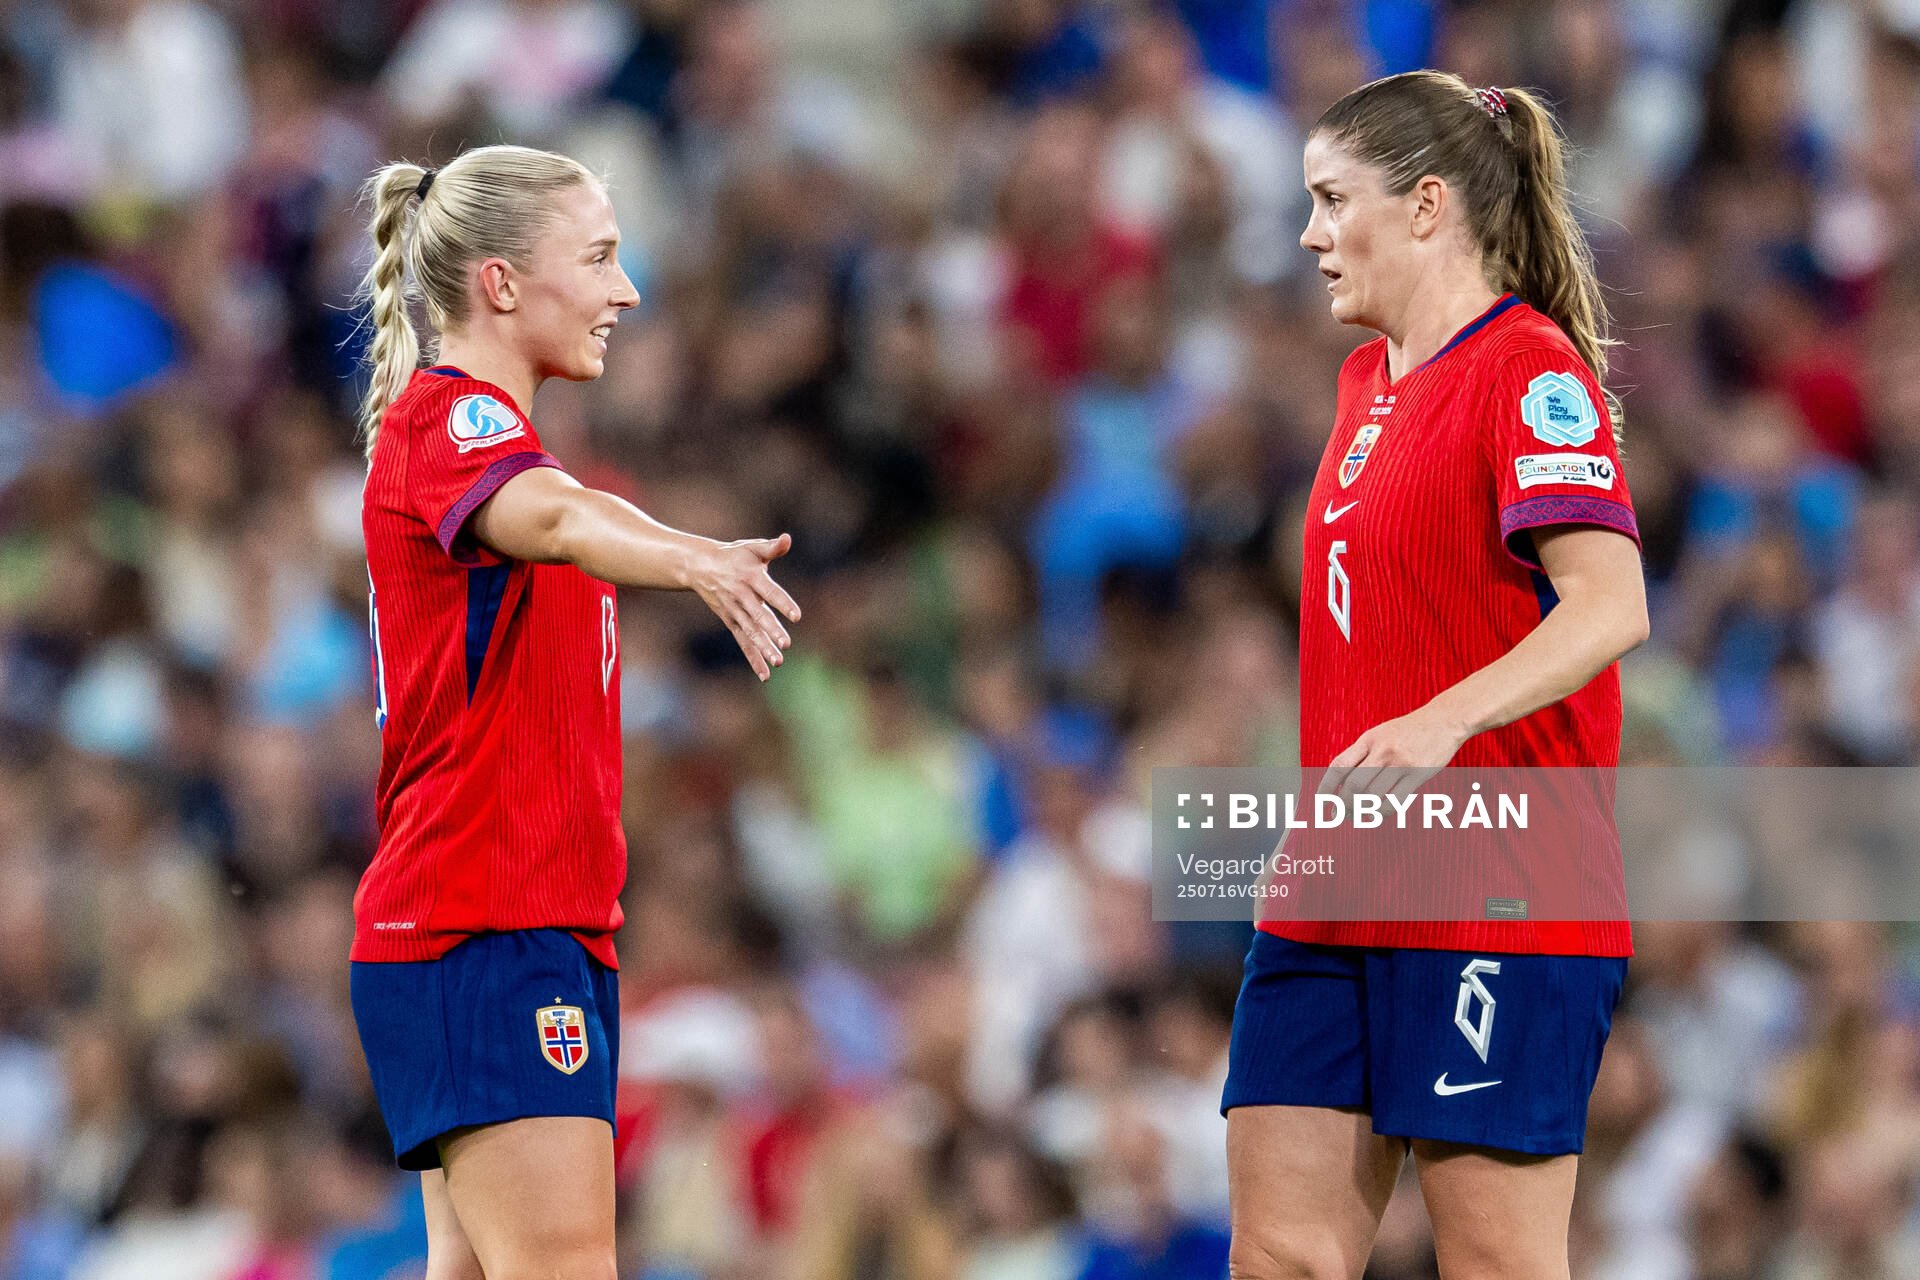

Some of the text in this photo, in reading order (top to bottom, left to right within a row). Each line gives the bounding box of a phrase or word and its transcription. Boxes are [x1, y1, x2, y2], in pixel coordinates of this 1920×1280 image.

[1546, 395, 1561, 404] We
[1548, 404, 1568, 414] Play
[1549, 412, 1580, 423] Strong
[1519, 463, 1586, 476] FOUNDATION
[1328, 540, 1350, 644] 6
[1454, 958, 1501, 1065] 6
